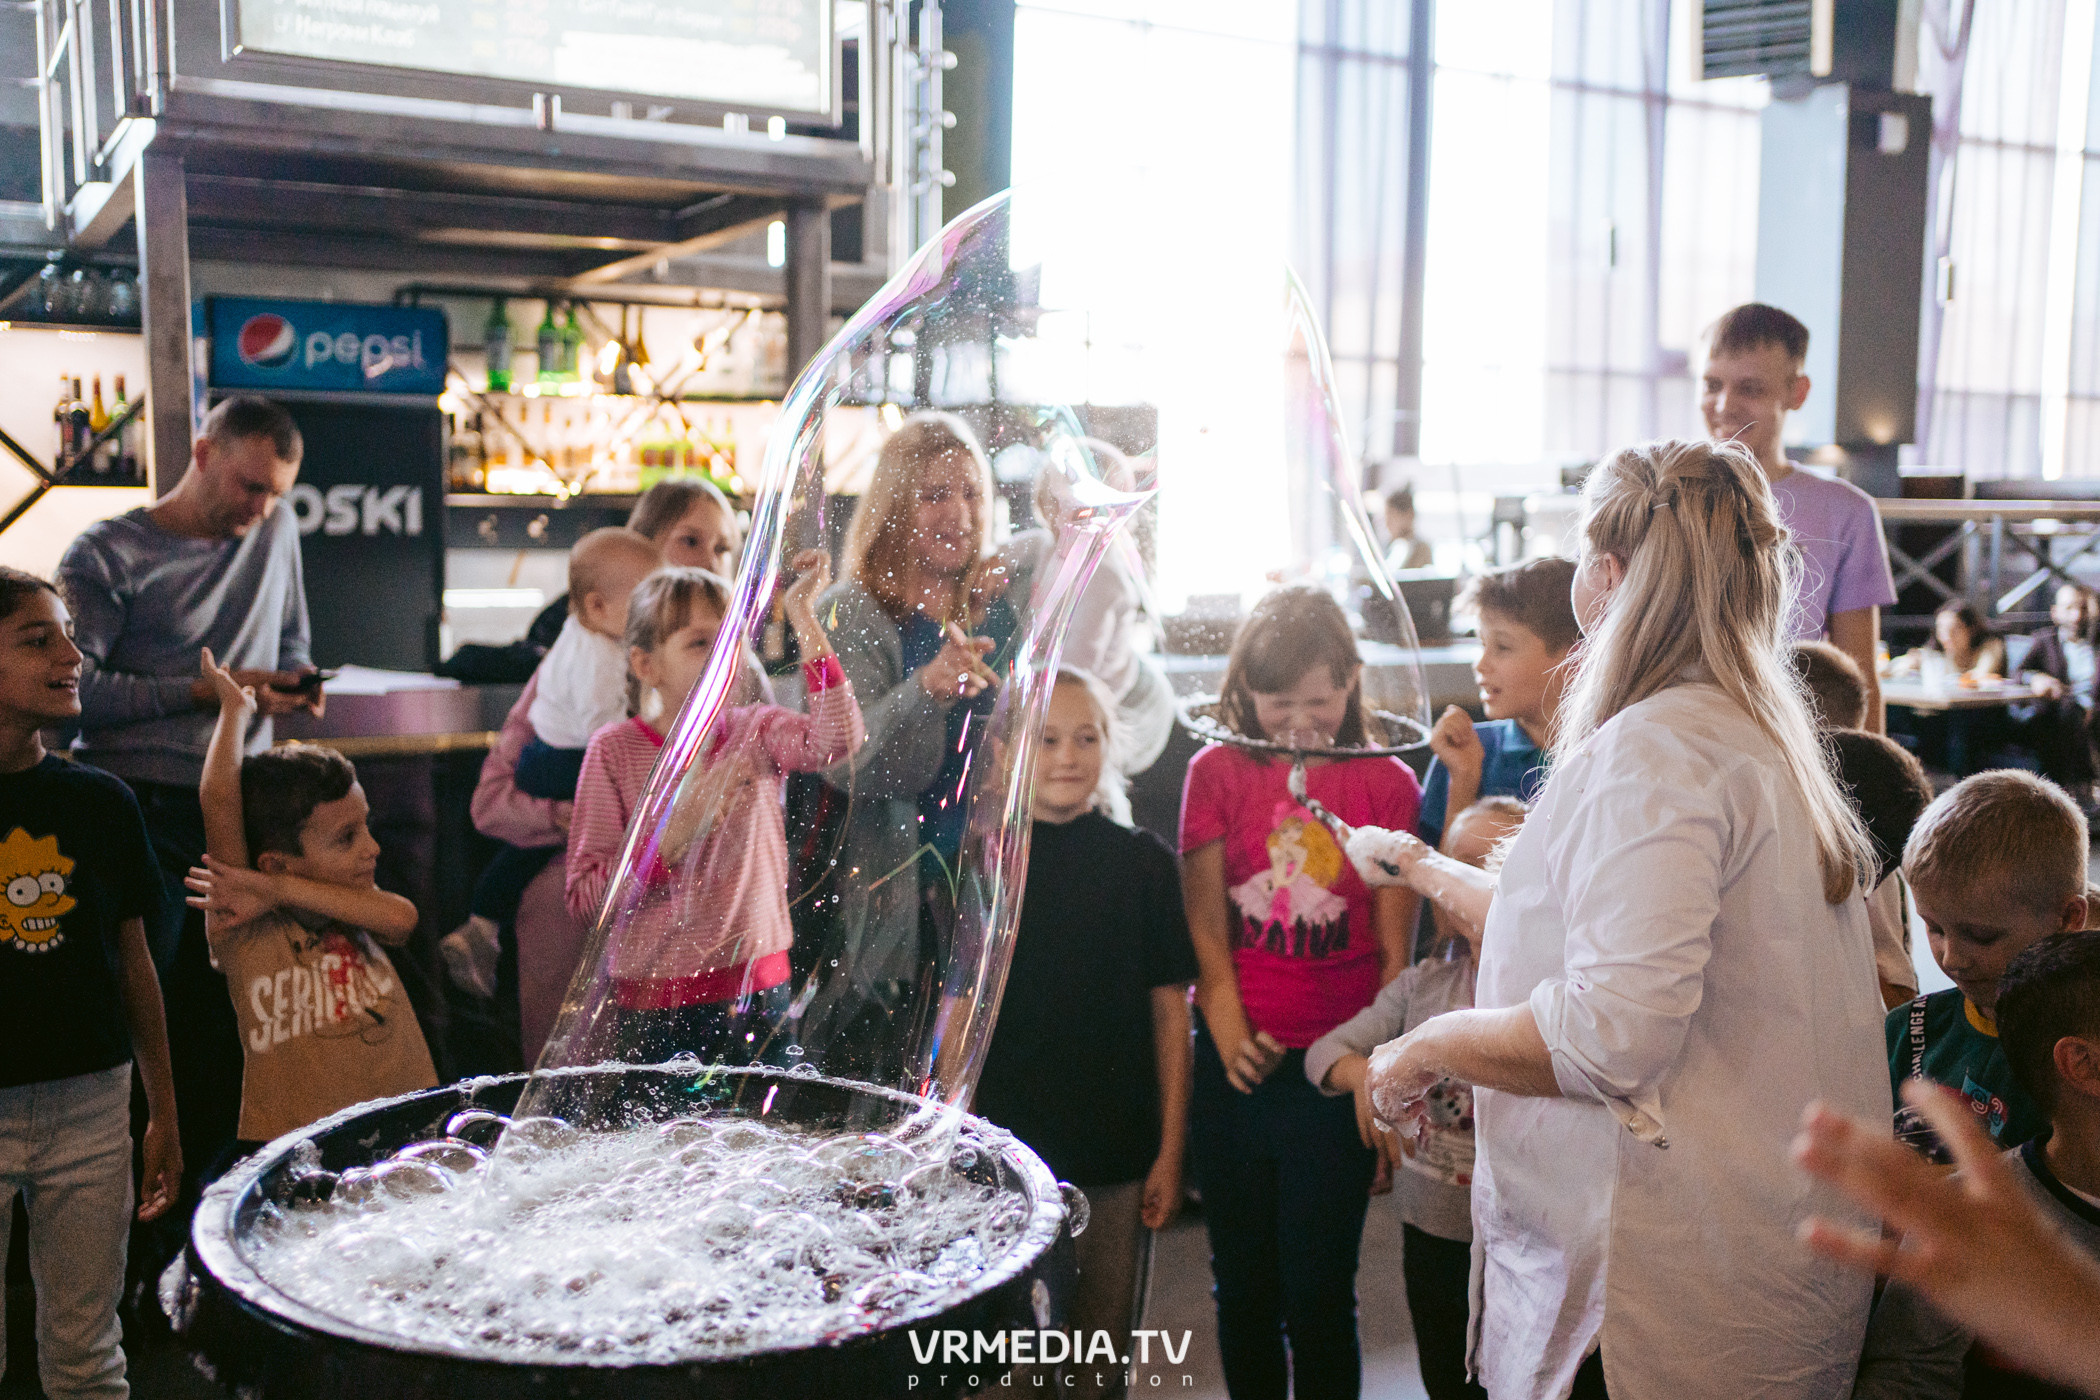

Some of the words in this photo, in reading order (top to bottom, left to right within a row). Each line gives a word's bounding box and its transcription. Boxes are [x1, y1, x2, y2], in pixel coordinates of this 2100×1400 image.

[305, 330, 424, 378] pepsi
[291, 482, 422, 536] OSKI
[1910, 1010, 1926, 1082] CHALLENGE
